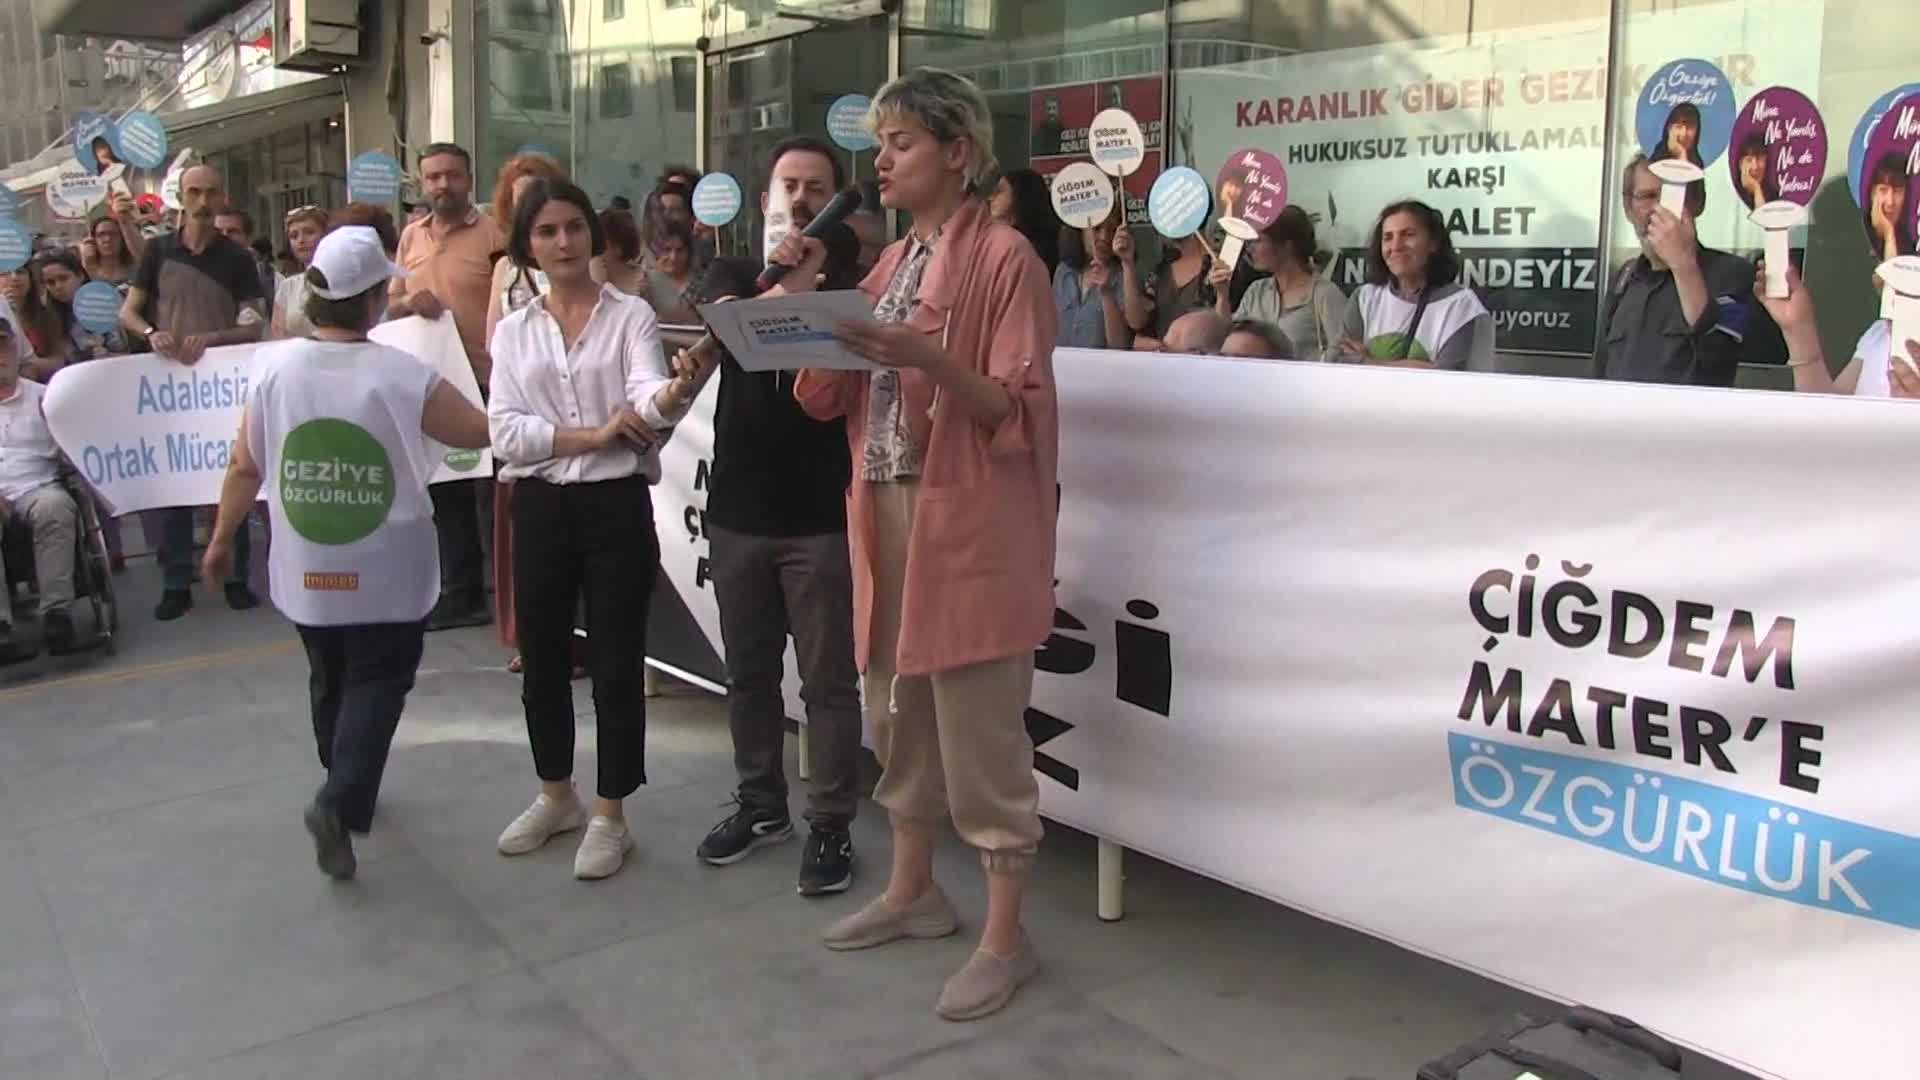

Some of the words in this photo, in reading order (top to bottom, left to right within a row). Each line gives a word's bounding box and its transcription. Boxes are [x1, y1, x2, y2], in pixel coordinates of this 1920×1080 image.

[1236, 87, 1388, 128] KARANLIK
[1401, 73, 1505, 113] GİDER
[1764, 120, 1782, 146] Ne
[1289, 137, 1408, 164] HUKUKSUZ
[1777, 146, 1795, 172] Ne
[1798, 149, 1814, 164] de
[1056, 178, 1096, 196] ÇİĞDEM
[1427, 165, 1506, 195] KARŞI
[1437, 206, 1536, 236] ALET
[1492, 310, 1571, 331] uyoruz
[137, 366, 249, 415] Adaletsiz
[83, 436, 159, 486] Ortak
[166, 428, 239, 473] Müca
[283, 456, 385, 484] GEZİ'YE
[284, 483, 385, 505] ÖZGÜRLÜK
[1469, 553, 1796, 690] ÇİĞDEM
[1457, 660, 1824, 794] MATER'E
[1460, 741, 1873, 911] ÖZGÜRLÜK
